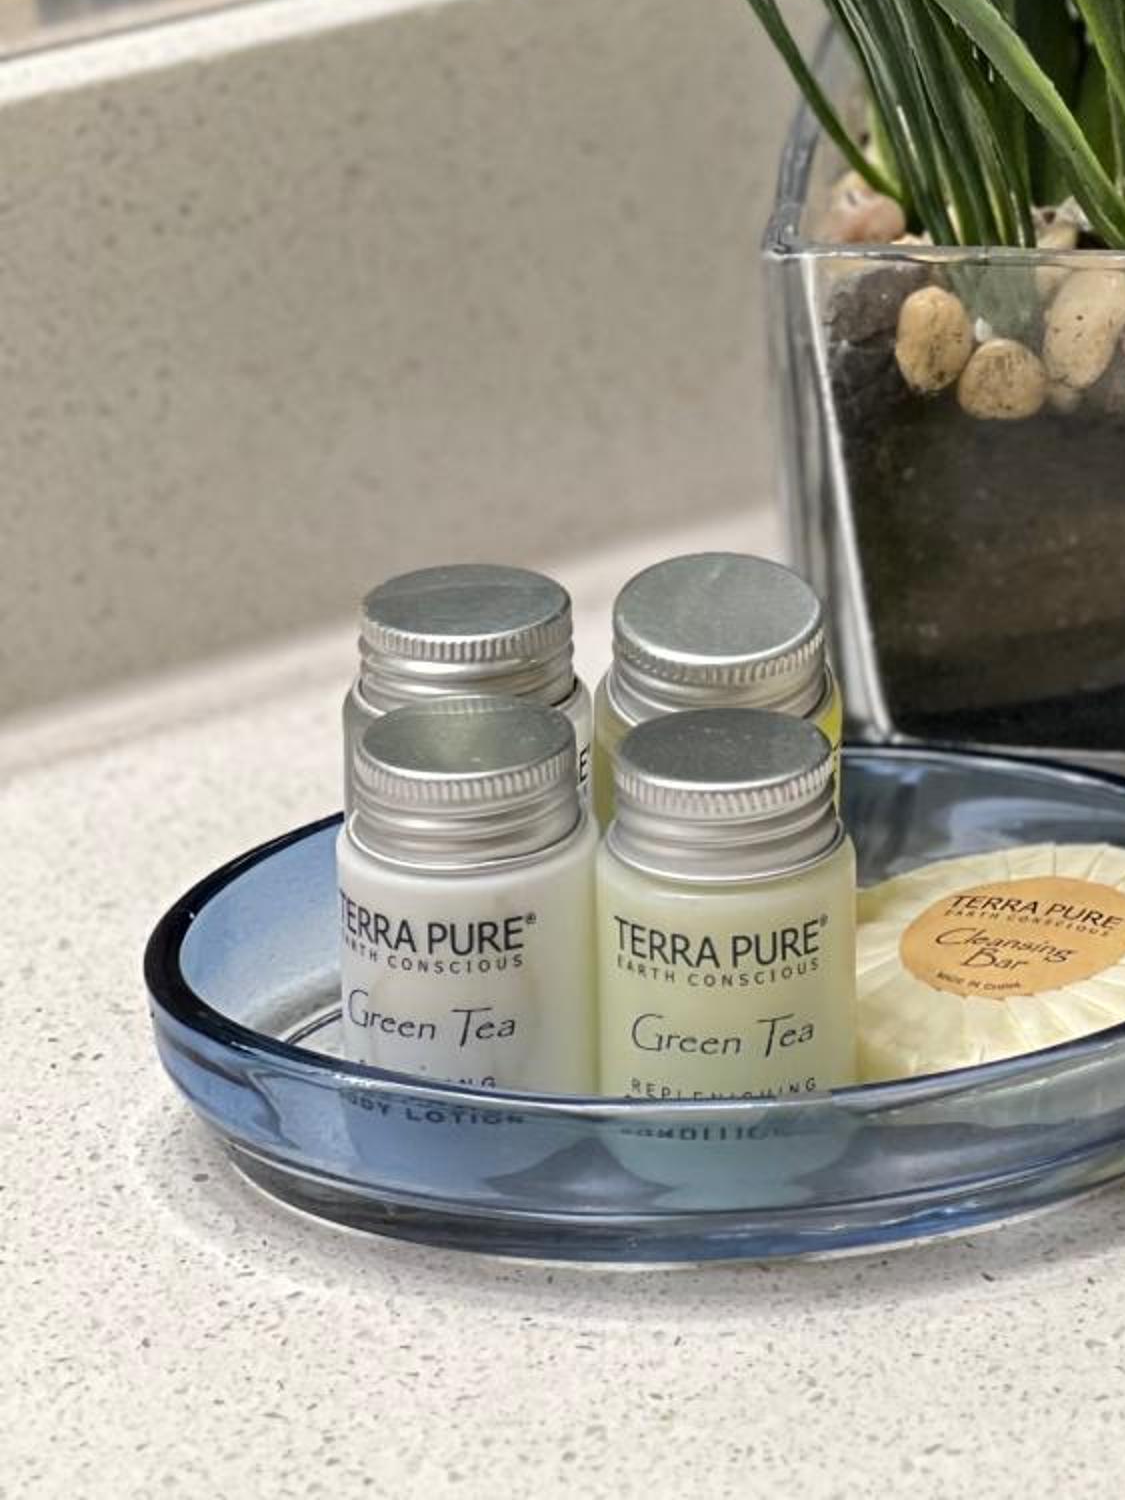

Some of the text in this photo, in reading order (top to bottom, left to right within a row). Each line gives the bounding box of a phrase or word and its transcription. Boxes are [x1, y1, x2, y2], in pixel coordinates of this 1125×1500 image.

[949, 894, 1039, 916] TERRA
[943, 908, 1114, 938] EARTH CONSCIOUS
[613, 915, 720, 968] TERRA
[934, 927, 1080, 964] Cleansing
[959, 947, 1030, 970] Bar
[386, 953, 524, 976] CONSCIOUS
[616, 953, 820, 988] EARTH CONSCIOUS
[348, 988, 517, 1048] Green Tea
[630, 1012, 815, 1058] Green Tea
